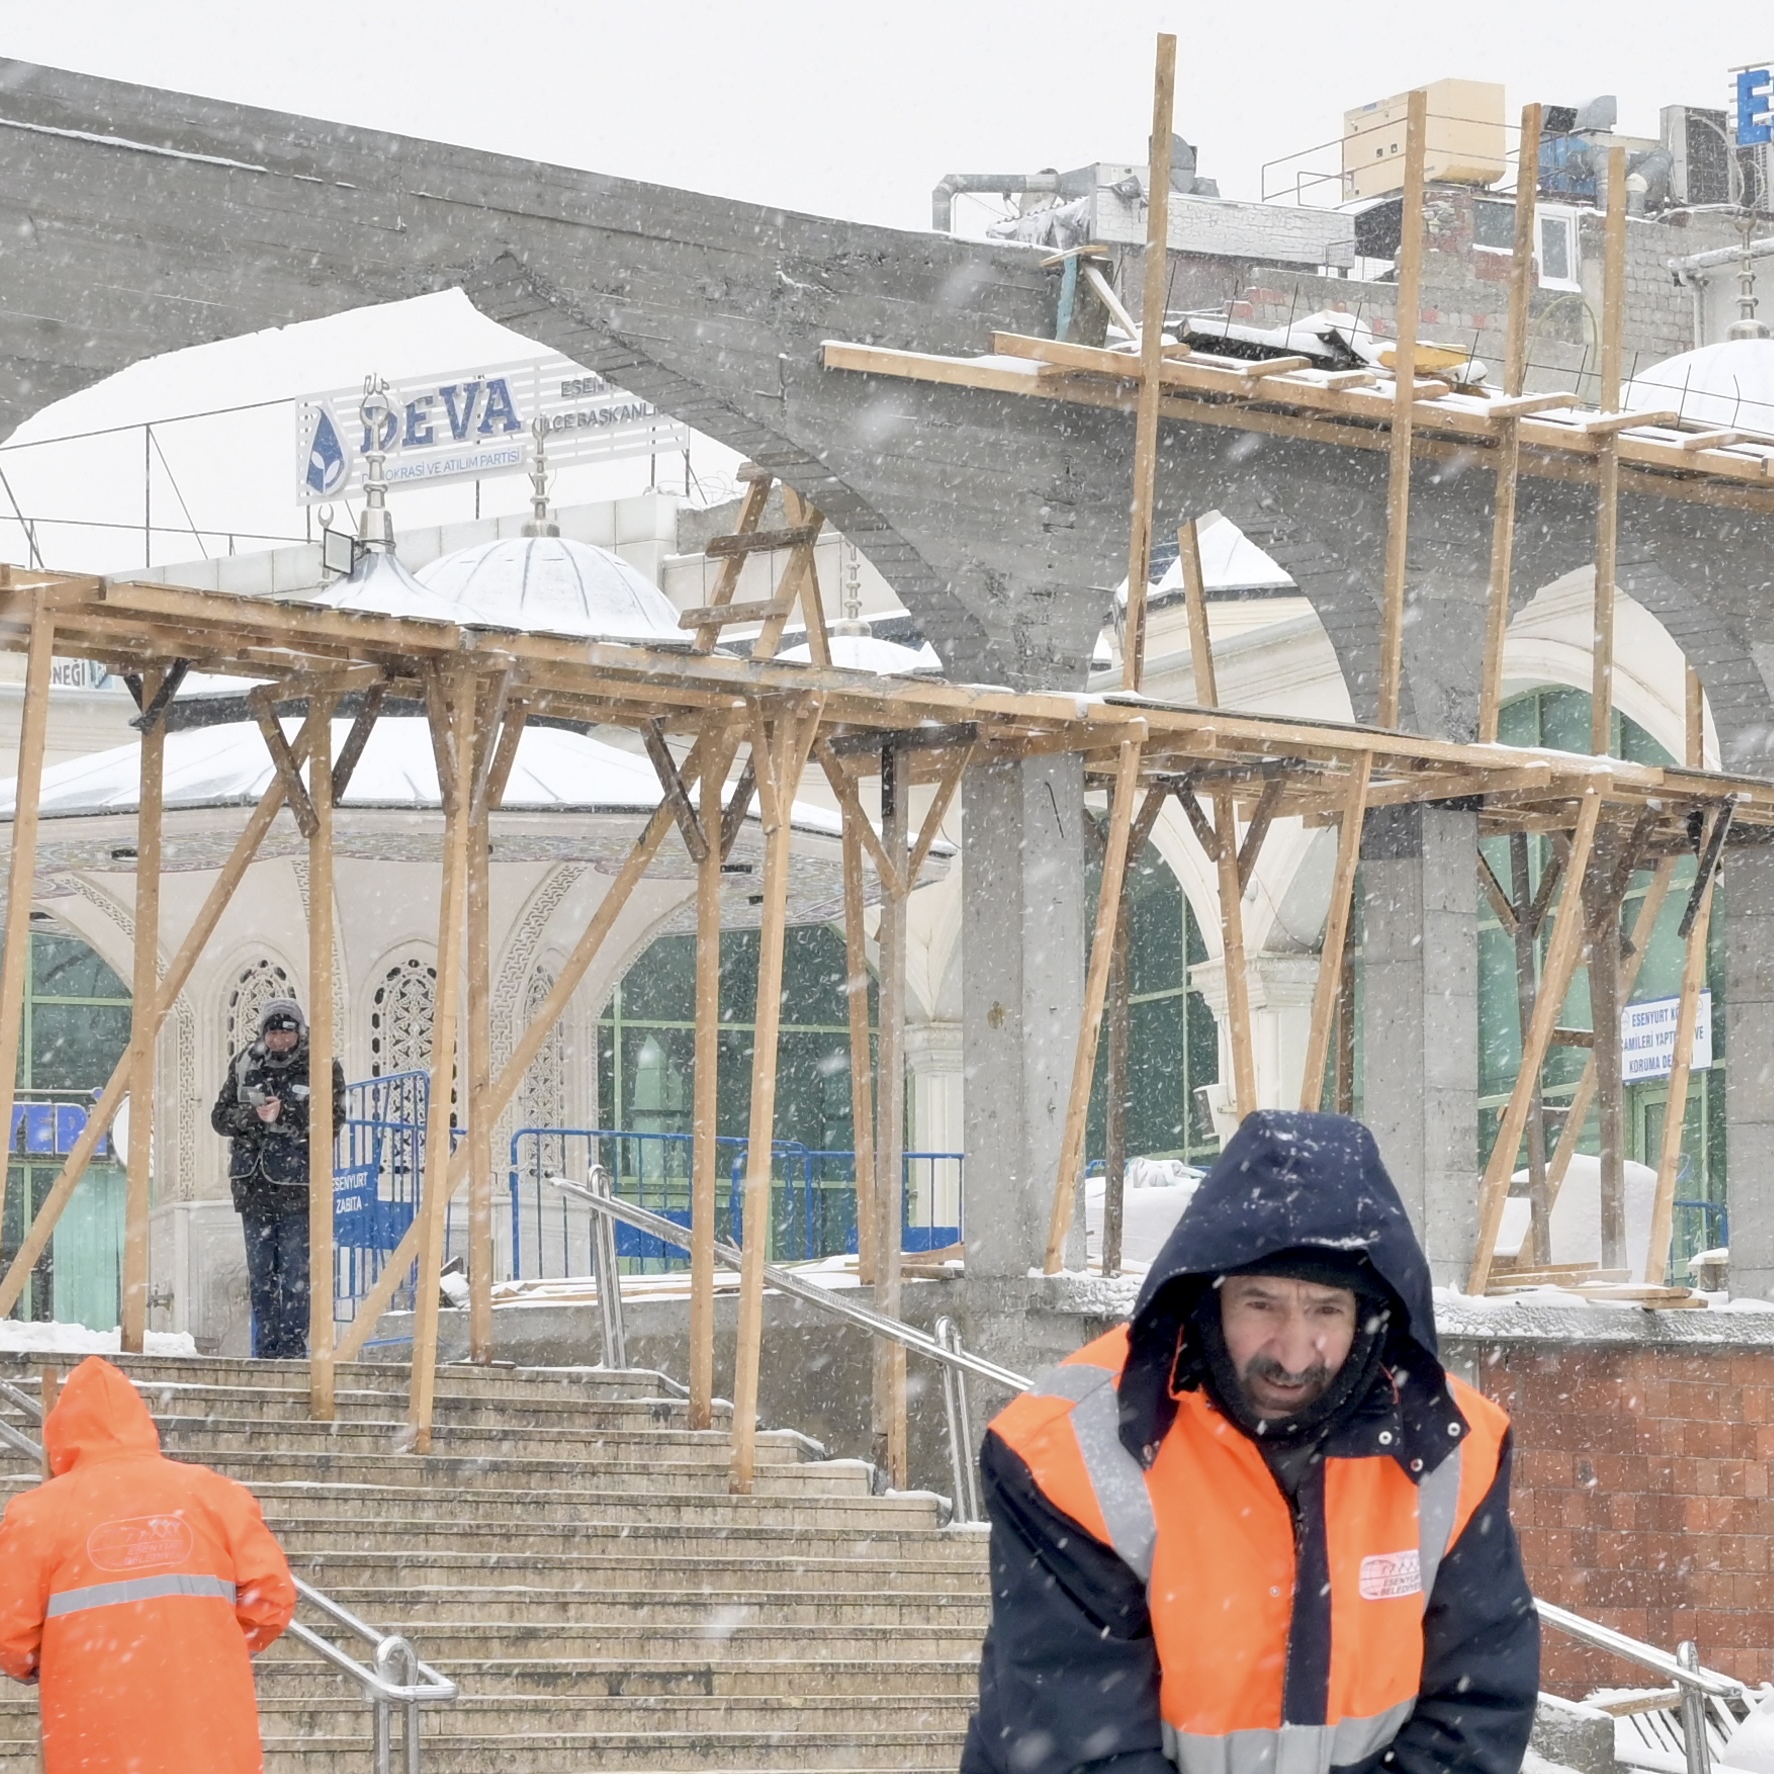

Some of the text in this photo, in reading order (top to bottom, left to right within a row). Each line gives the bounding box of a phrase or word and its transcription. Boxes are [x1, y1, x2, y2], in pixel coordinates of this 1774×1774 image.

[359, 377, 523, 454] DEVA
[427, 462, 442, 475] VE
[443, 456, 479, 473] ATILIM
[480, 448, 520, 468] PARTİSİ
[1632, 1008, 1669, 1027] ESENYURT
[1622, 1031, 1654, 1050] AMİLERİ
[1629, 1055, 1660, 1073] KORUMA
[1383, 1574, 1421, 1588] ESENYUR
